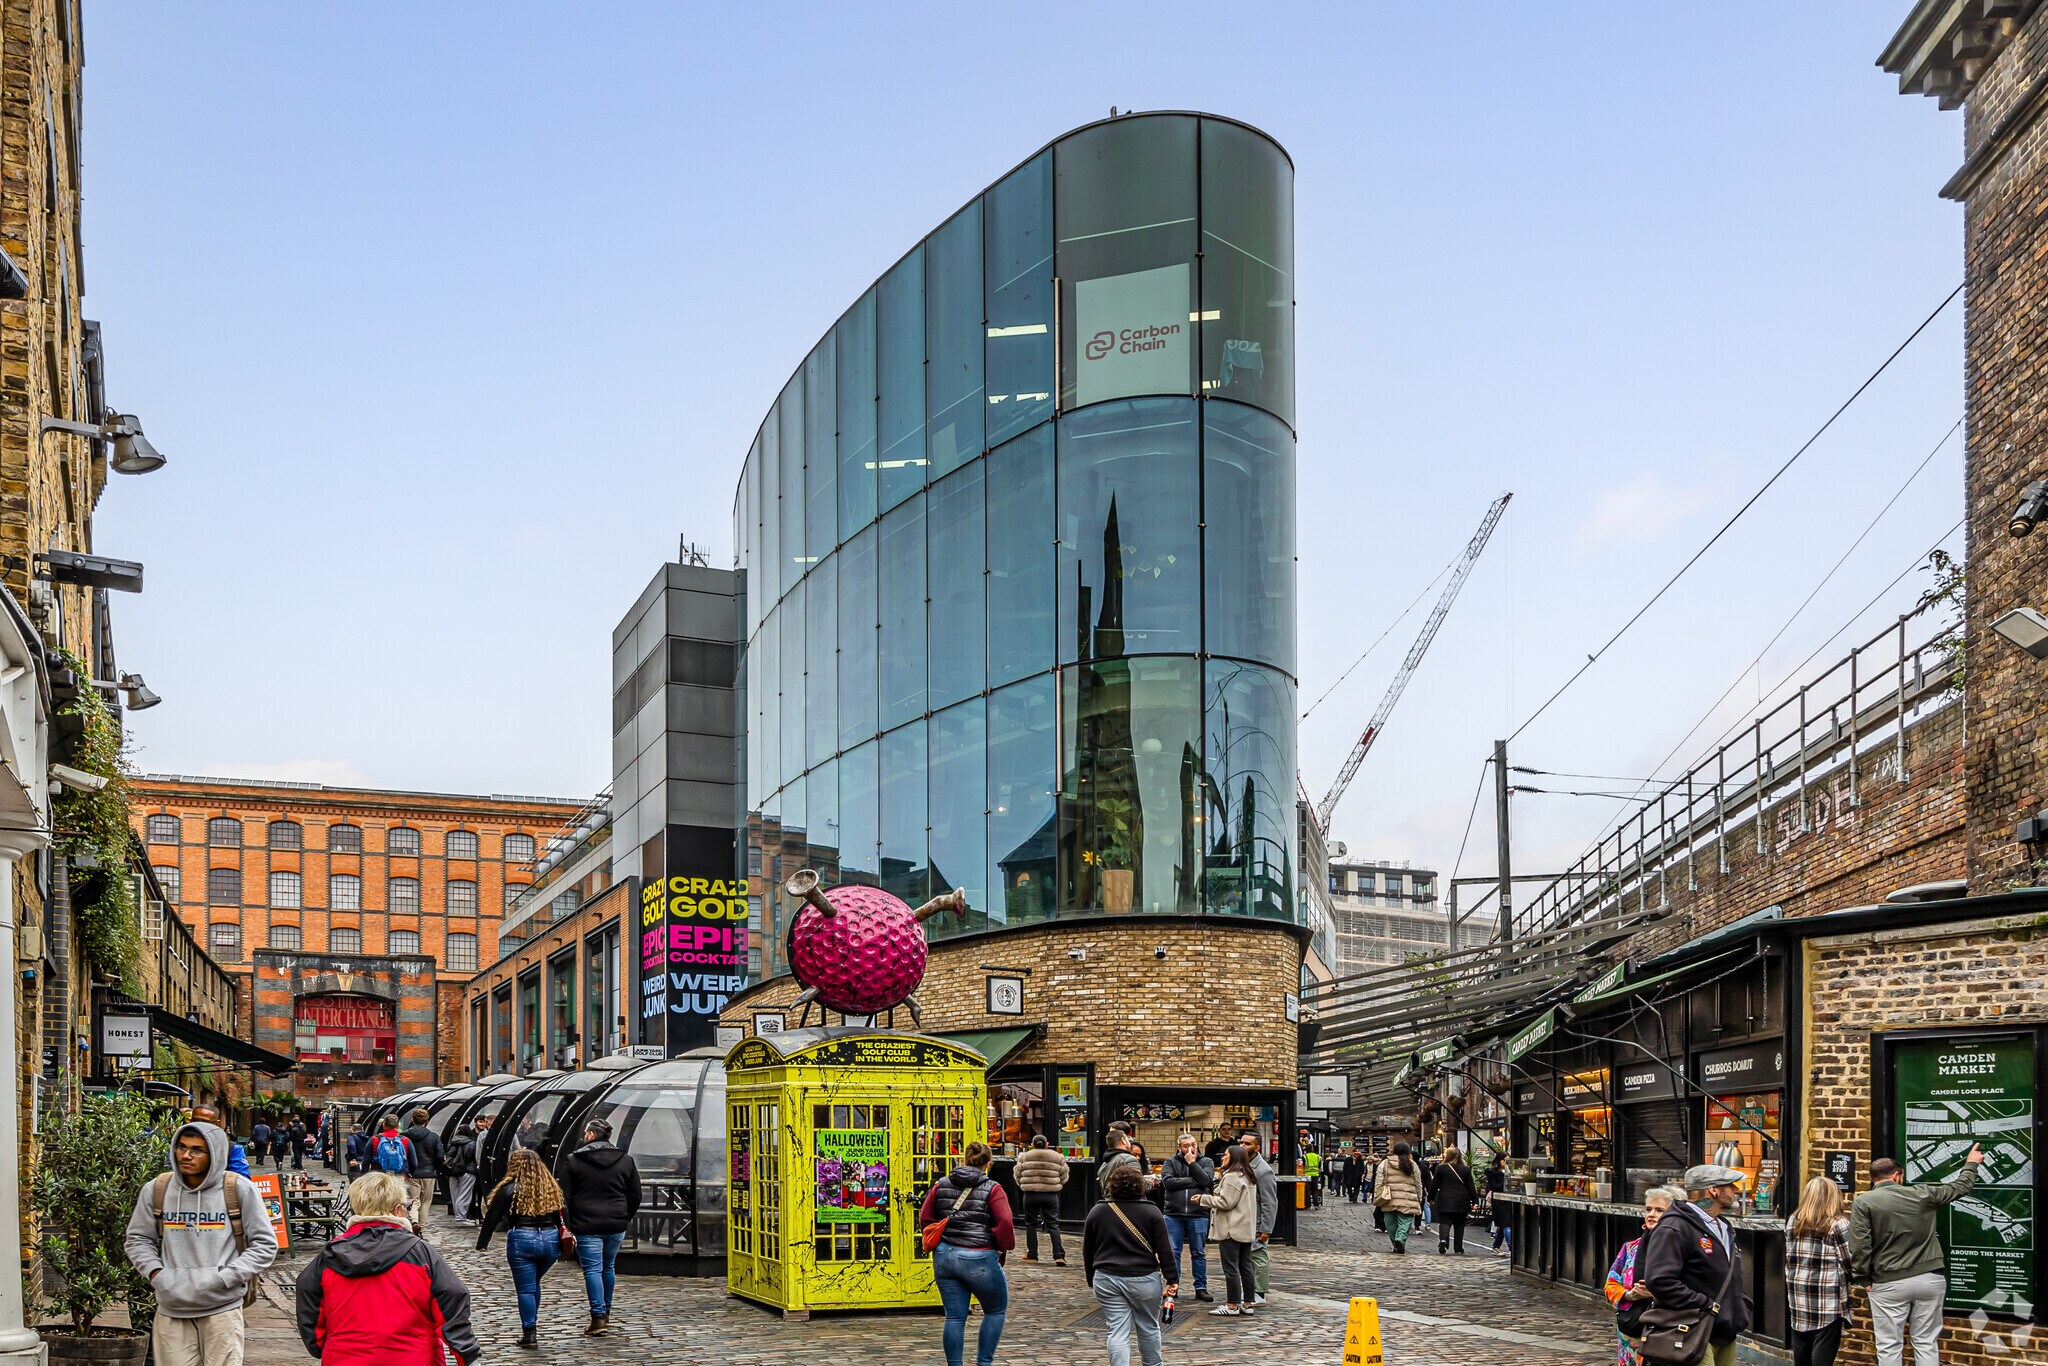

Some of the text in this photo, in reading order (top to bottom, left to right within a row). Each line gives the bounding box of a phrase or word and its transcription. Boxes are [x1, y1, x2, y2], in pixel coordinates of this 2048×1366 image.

[1120, 324, 1180, 341] Carbon
[1120, 338, 1166, 354] Chain
[643, 878, 665, 904] CRAZY
[644, 897, 665, 926] GOLF
[644, 926, 665, 957] EPIC
[670, 924, 735, 951] EPI
[644, 952, 665, 970] COCKTAILS
[643, 974, 665, 996] WEIRD
[339, 997, 353, 1008] THE
[644, 993, 665, 1018] JUNK
[300, 1008, 392, 1029] INTERCHANGE
[1705, 1059, 1753, 1075] CHURROS DONUT
[1938, 1053, 1996, 1064] CAMDEN
[1939, 1065, 1995, 1075] MARKET
[1625, 1073, 1655, 1086] CAMDEN PIZZA
[825, 1134, 884, 1147] HALLOWEEN
